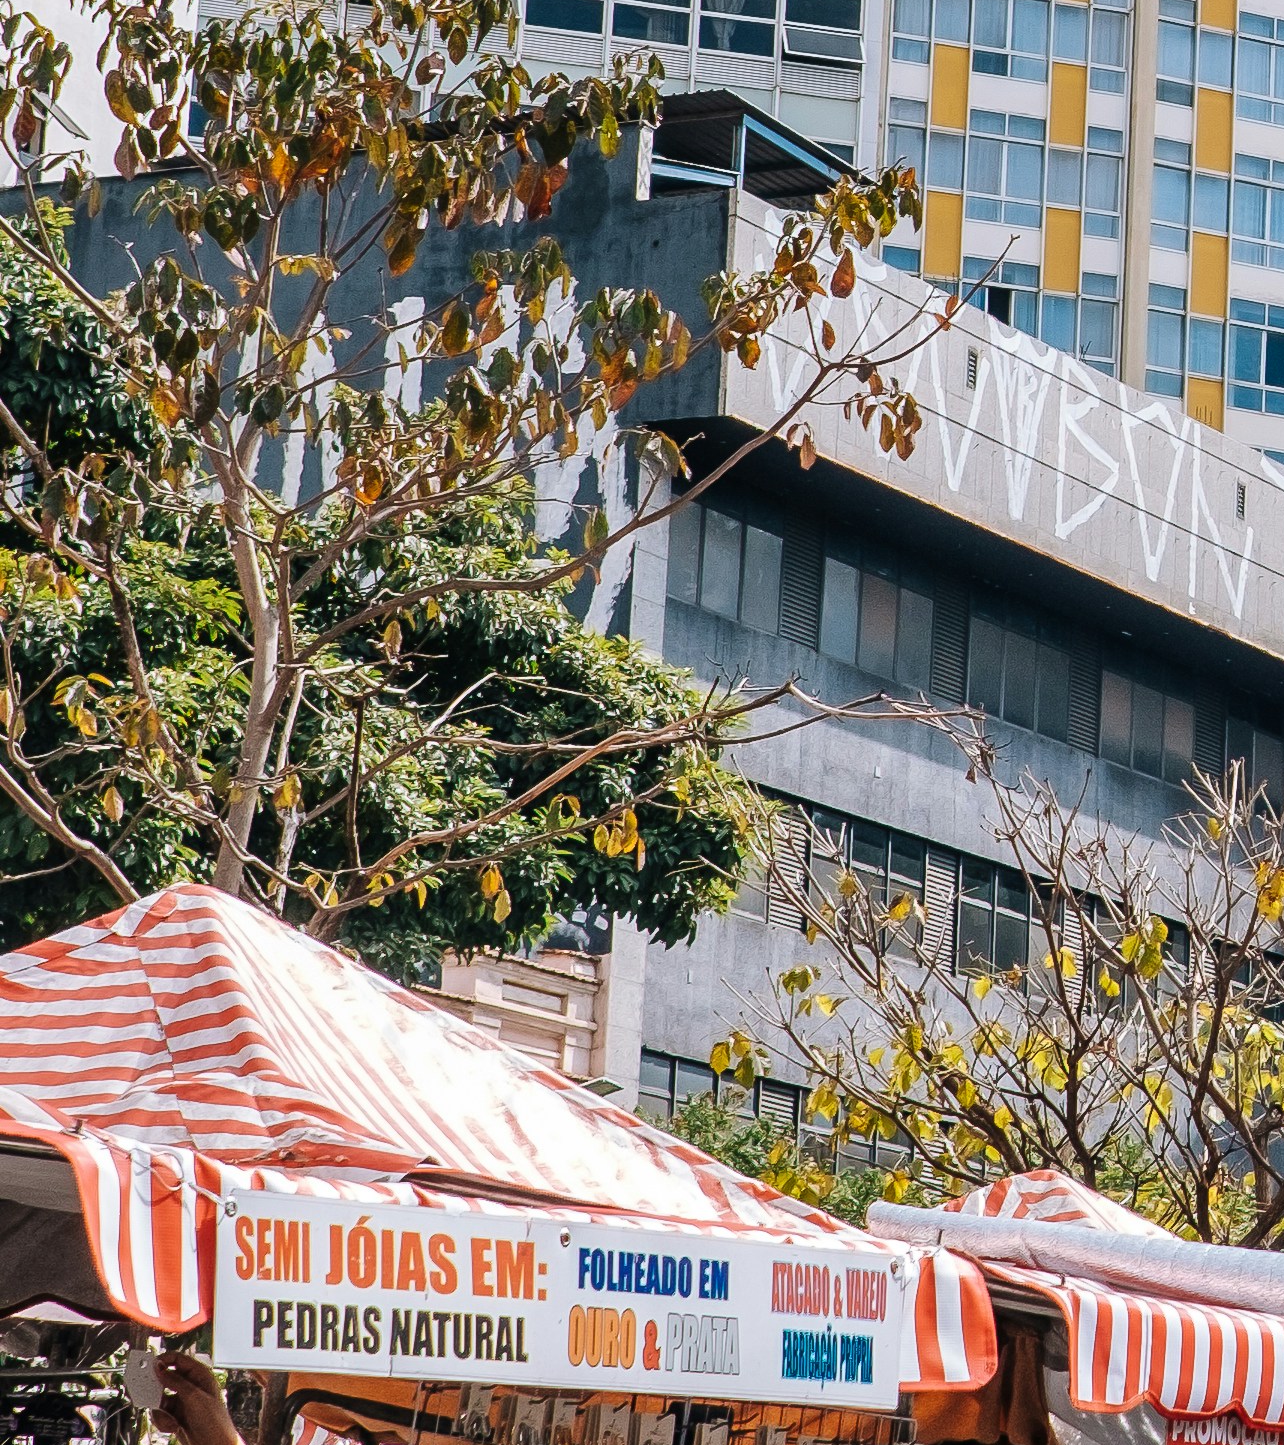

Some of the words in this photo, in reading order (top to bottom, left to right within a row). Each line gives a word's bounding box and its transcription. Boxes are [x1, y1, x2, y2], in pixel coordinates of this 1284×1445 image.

[235, 1215, 311, 1284] SEMI
[325, 1215, 458, 1295] JÓIAS
[470, 1237, 547, 1302] EM:
[578, 1247, 692, 1299] FOLHEADO
[698, 1258, 730, 1301] EM
[771, 1260, 831, 1318] ATACADO
[833, 1275, 843, 1319] &
[846, 1267, 887, 1323] VAREJO
[253, 1298, 382, 1355] PEDRAS
[389, 1307, 529, 1363] NATURAL
[568, 1304, 636, 1370] OURO
[643, 1319, 661, 1371] &
[665, 1312, 741, 1376] PRATA
